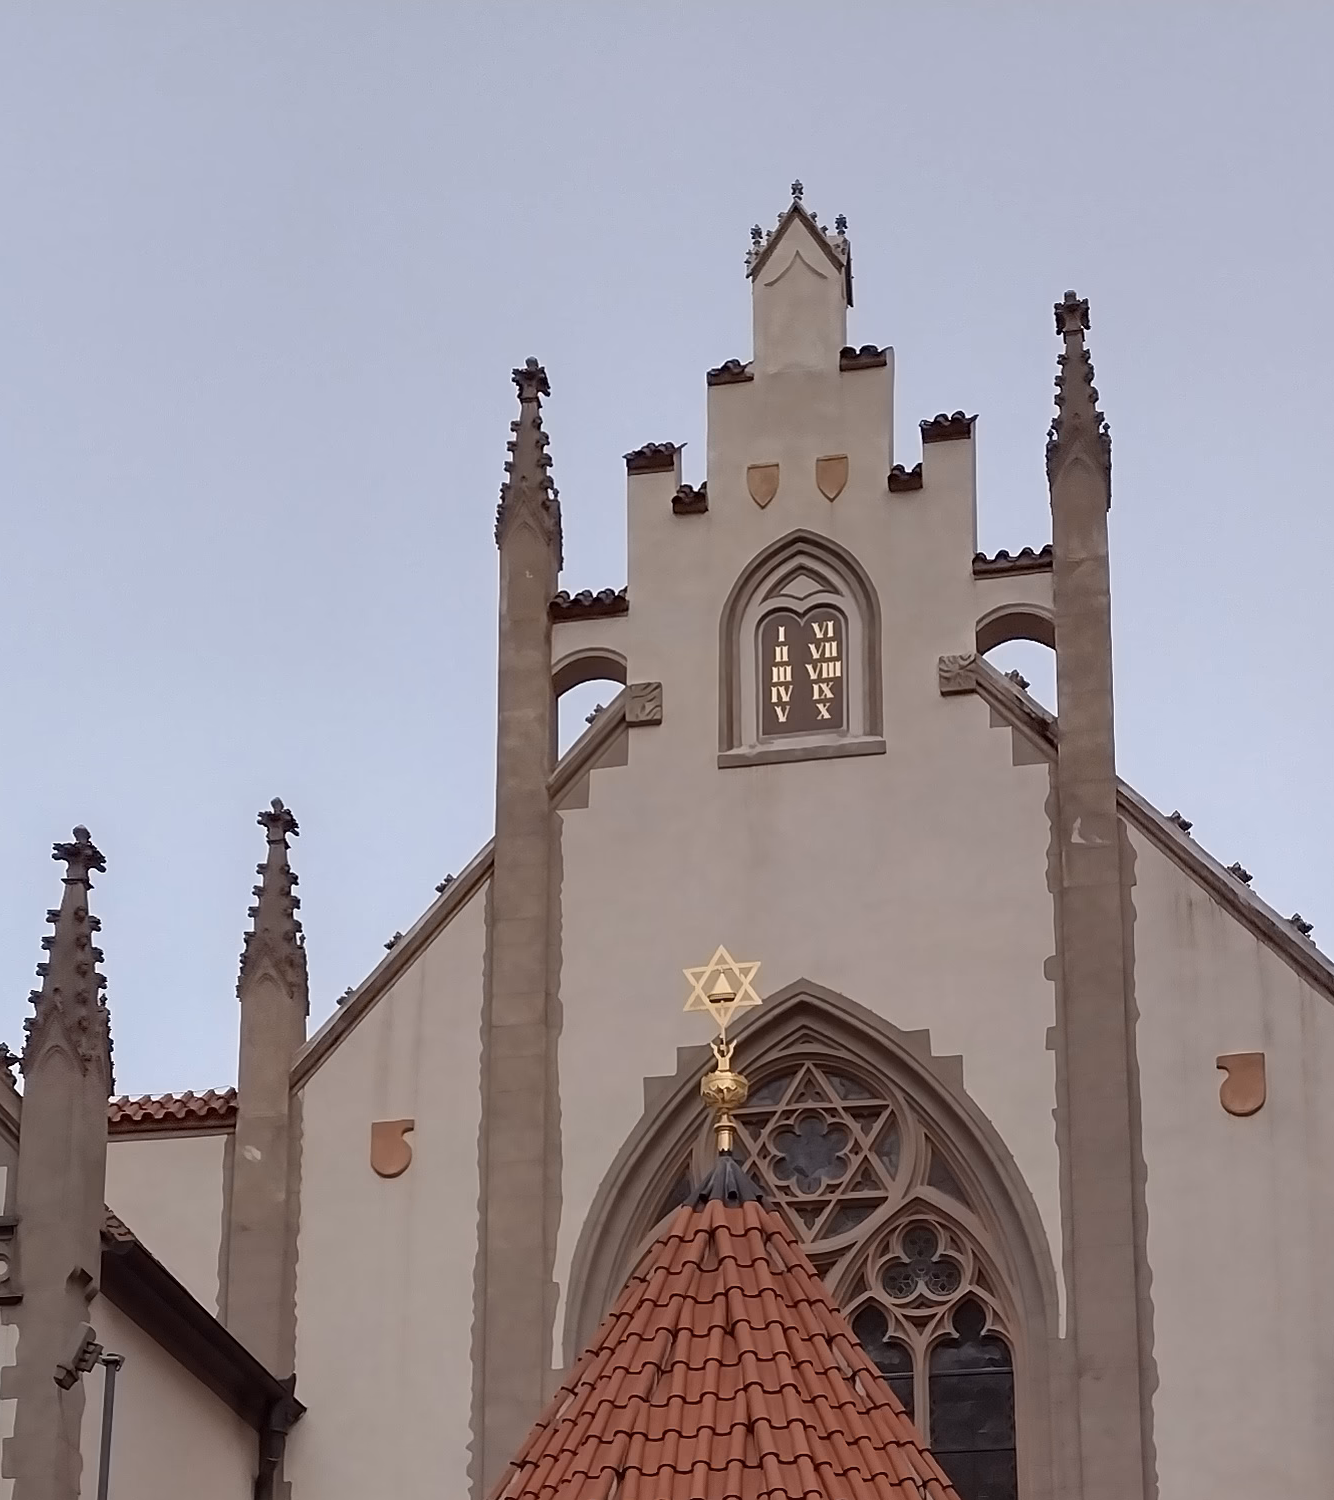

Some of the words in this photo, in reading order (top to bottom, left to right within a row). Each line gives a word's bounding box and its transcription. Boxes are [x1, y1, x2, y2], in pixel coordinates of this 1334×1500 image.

[778, 626, 786, 642] I
[811, 620, 835, 639] VI
[774, 645, 789, 663] II
[808, 641, 838, 659] VII
[771, 665, 792, 683] III
[805, 660, 842, 680] VIII
[771, 685, 793, 703] IV
[812, 682, 834, 700] IX
[774, 705, 790, 722] V
[816, 702, 832, 720] X
